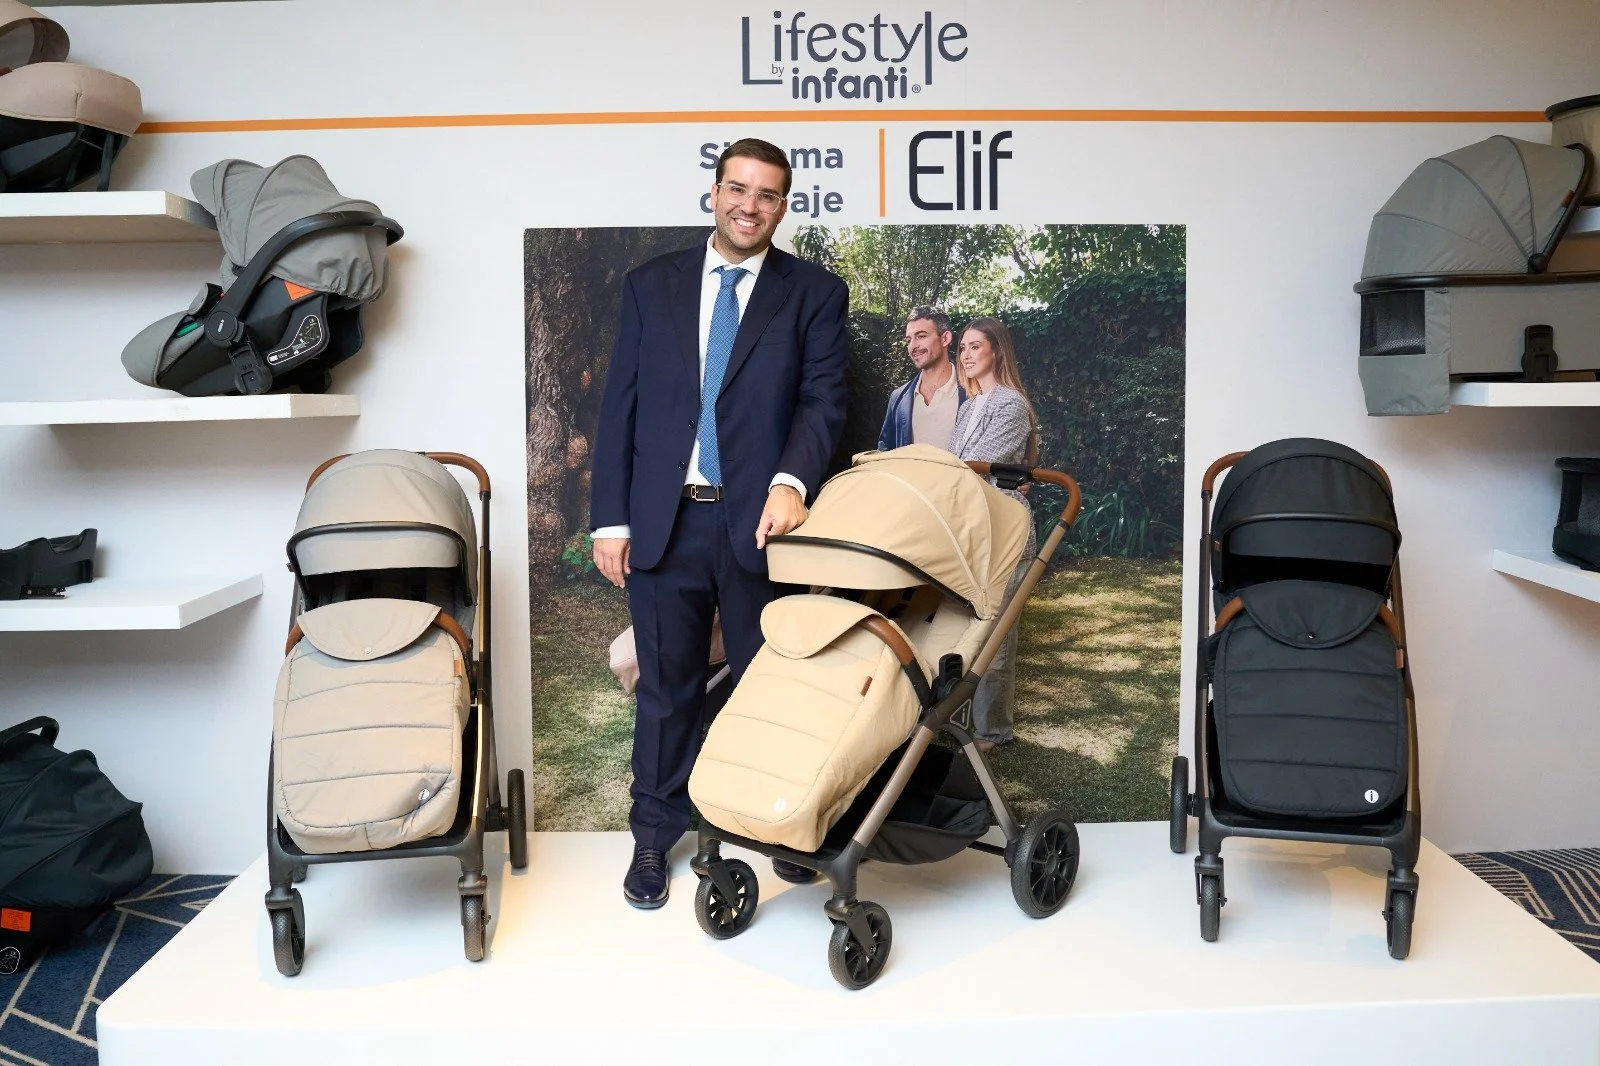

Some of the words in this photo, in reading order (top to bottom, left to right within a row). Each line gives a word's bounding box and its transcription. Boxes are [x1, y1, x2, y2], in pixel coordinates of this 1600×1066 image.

[741, 10, 969, 86] Lifestyle
[771, 63, 785, 77] by
[792, 66, 908, 103] infanti
[908, 130, 1013, 211] Elif
[790, 185, 844, 218] aje
